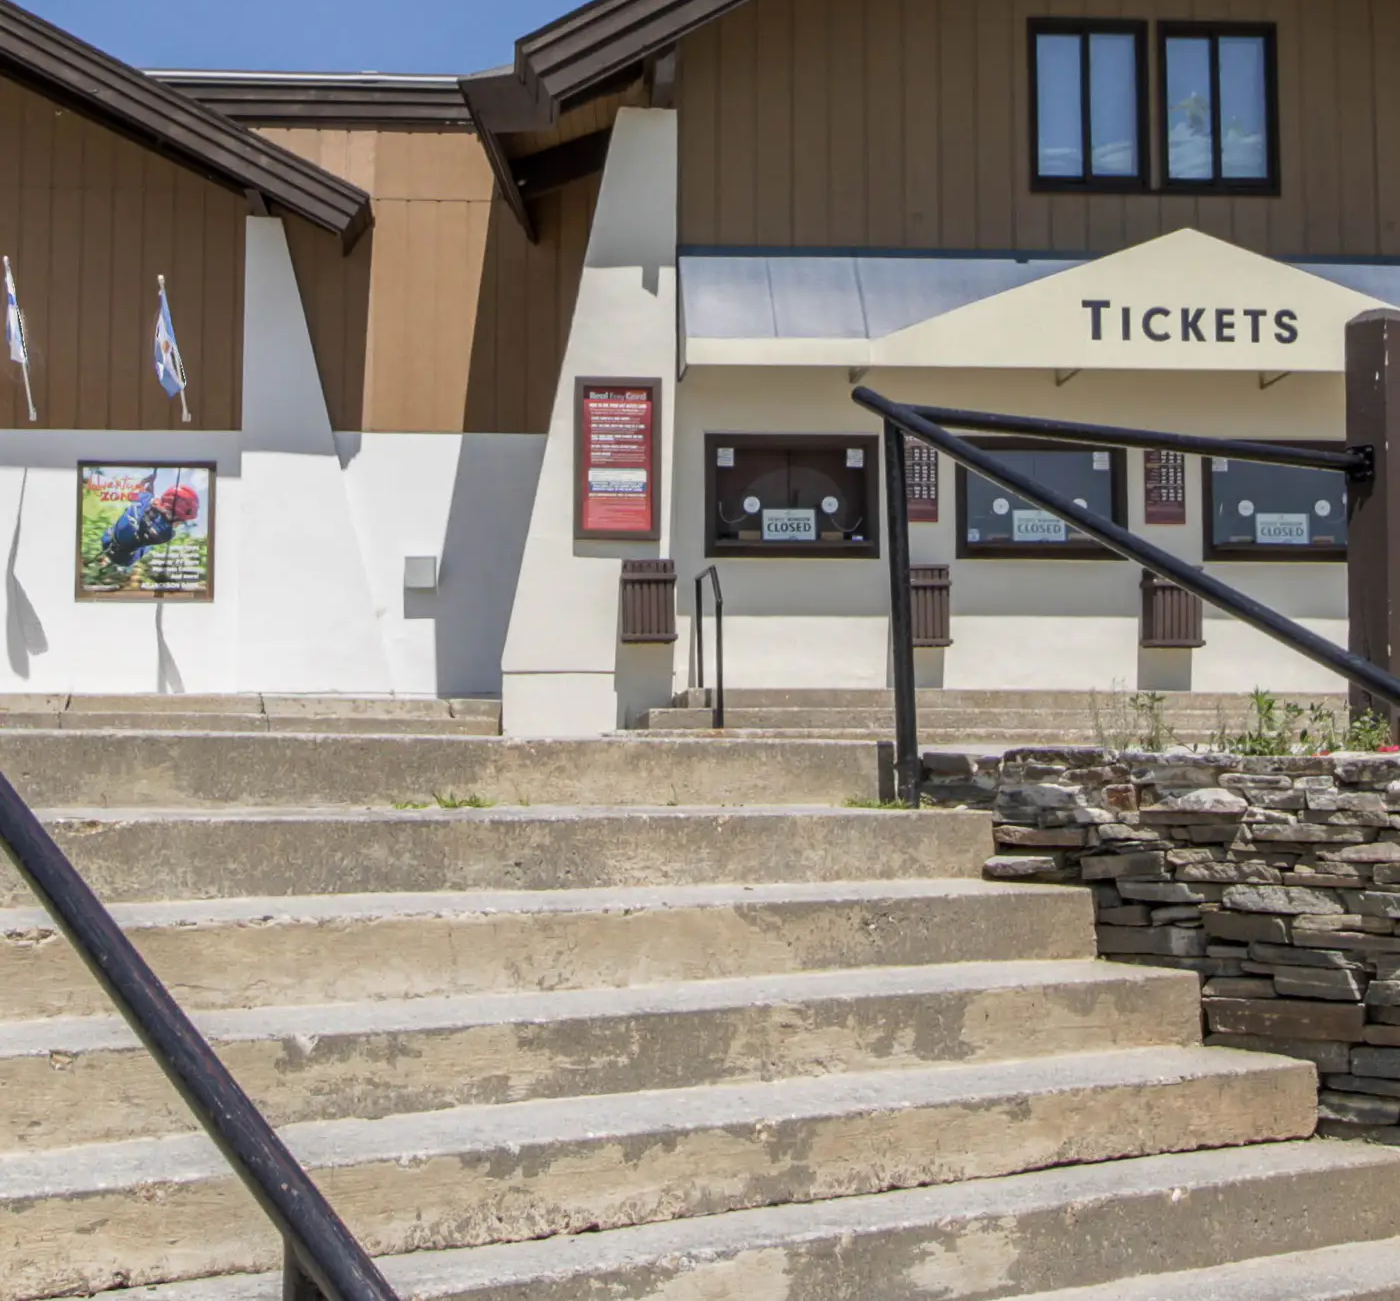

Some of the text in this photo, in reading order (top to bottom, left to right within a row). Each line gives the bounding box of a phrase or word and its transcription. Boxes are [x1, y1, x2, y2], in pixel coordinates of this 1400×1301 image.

[1081, 299, 1298, 344] TICKETS
[767, 522, 811, 532] CLOSED
[1018, 523, 1061, 534] CLOSED
[1260, 526, 1304, 536] CLOSED
